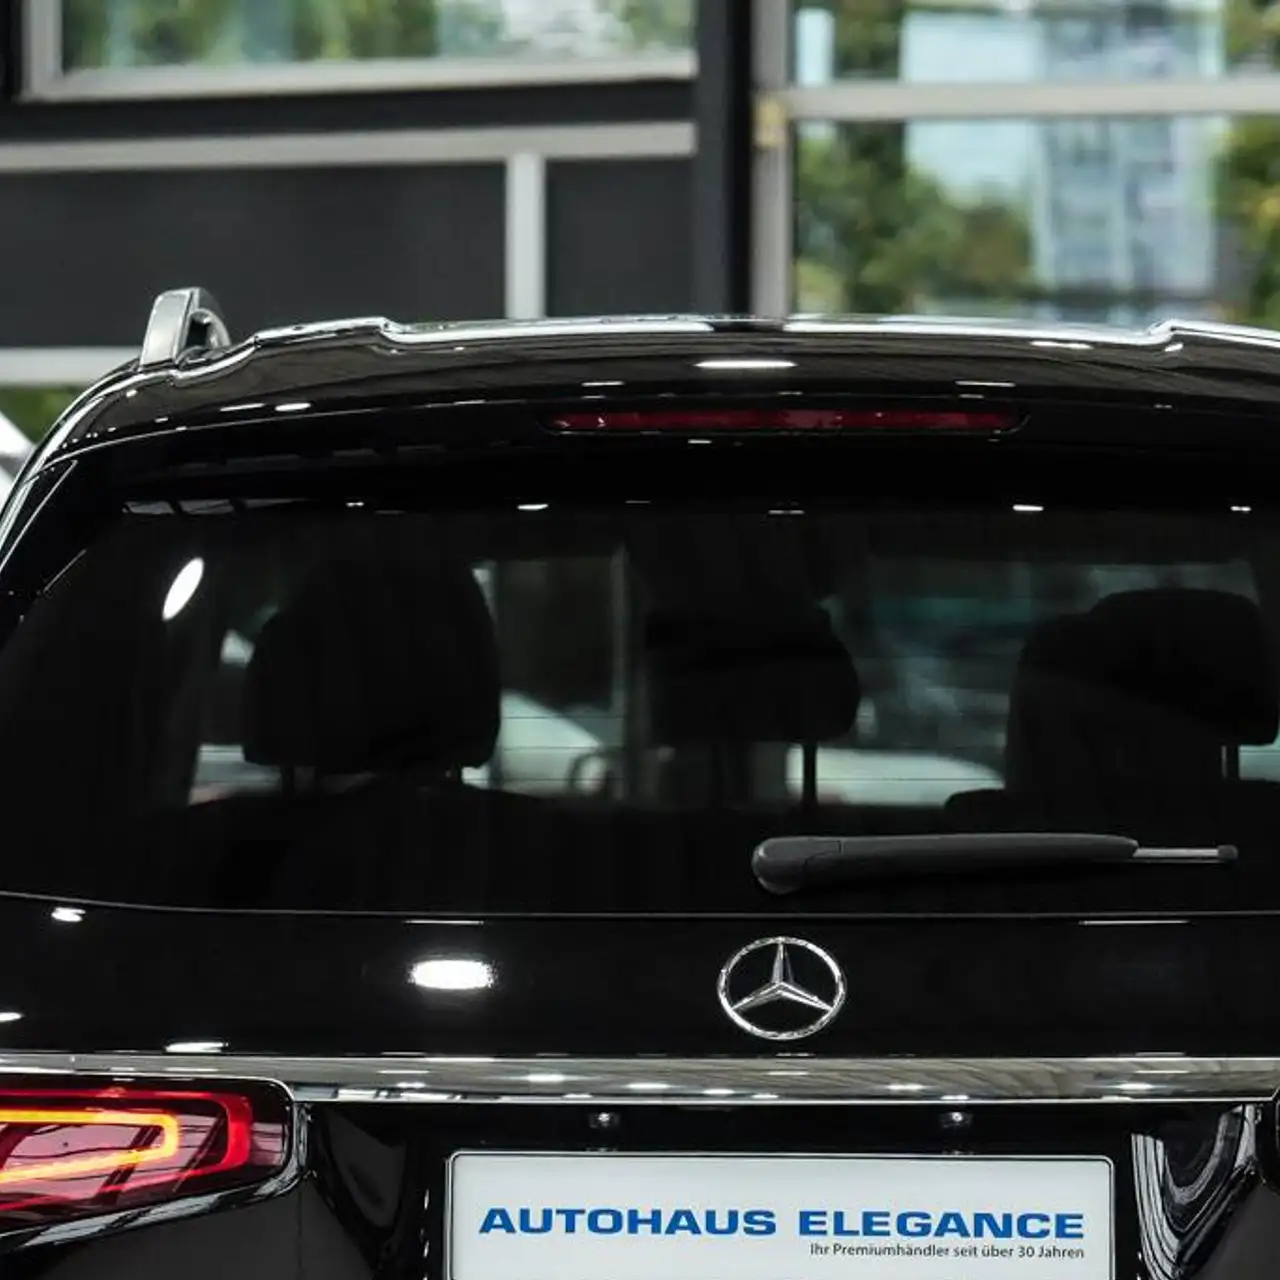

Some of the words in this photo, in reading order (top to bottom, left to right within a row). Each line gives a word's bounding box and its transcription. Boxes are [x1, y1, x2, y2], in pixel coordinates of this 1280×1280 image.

[479, 1207, 776, 1235] AUTOHAUS
[799, 1210, 1084, 1239] ELEGANCE
[810, 1243, 829, 1255] Ihr
[833, 1243, 949, 1257] Premiumhändler
[953, 1244, 977, 1257] seit
[982, 1244, 1014, 1259] über
[1018, 1246, 1034, 1258] 30
[1038, 1246, 1084, 1259] Jahren
